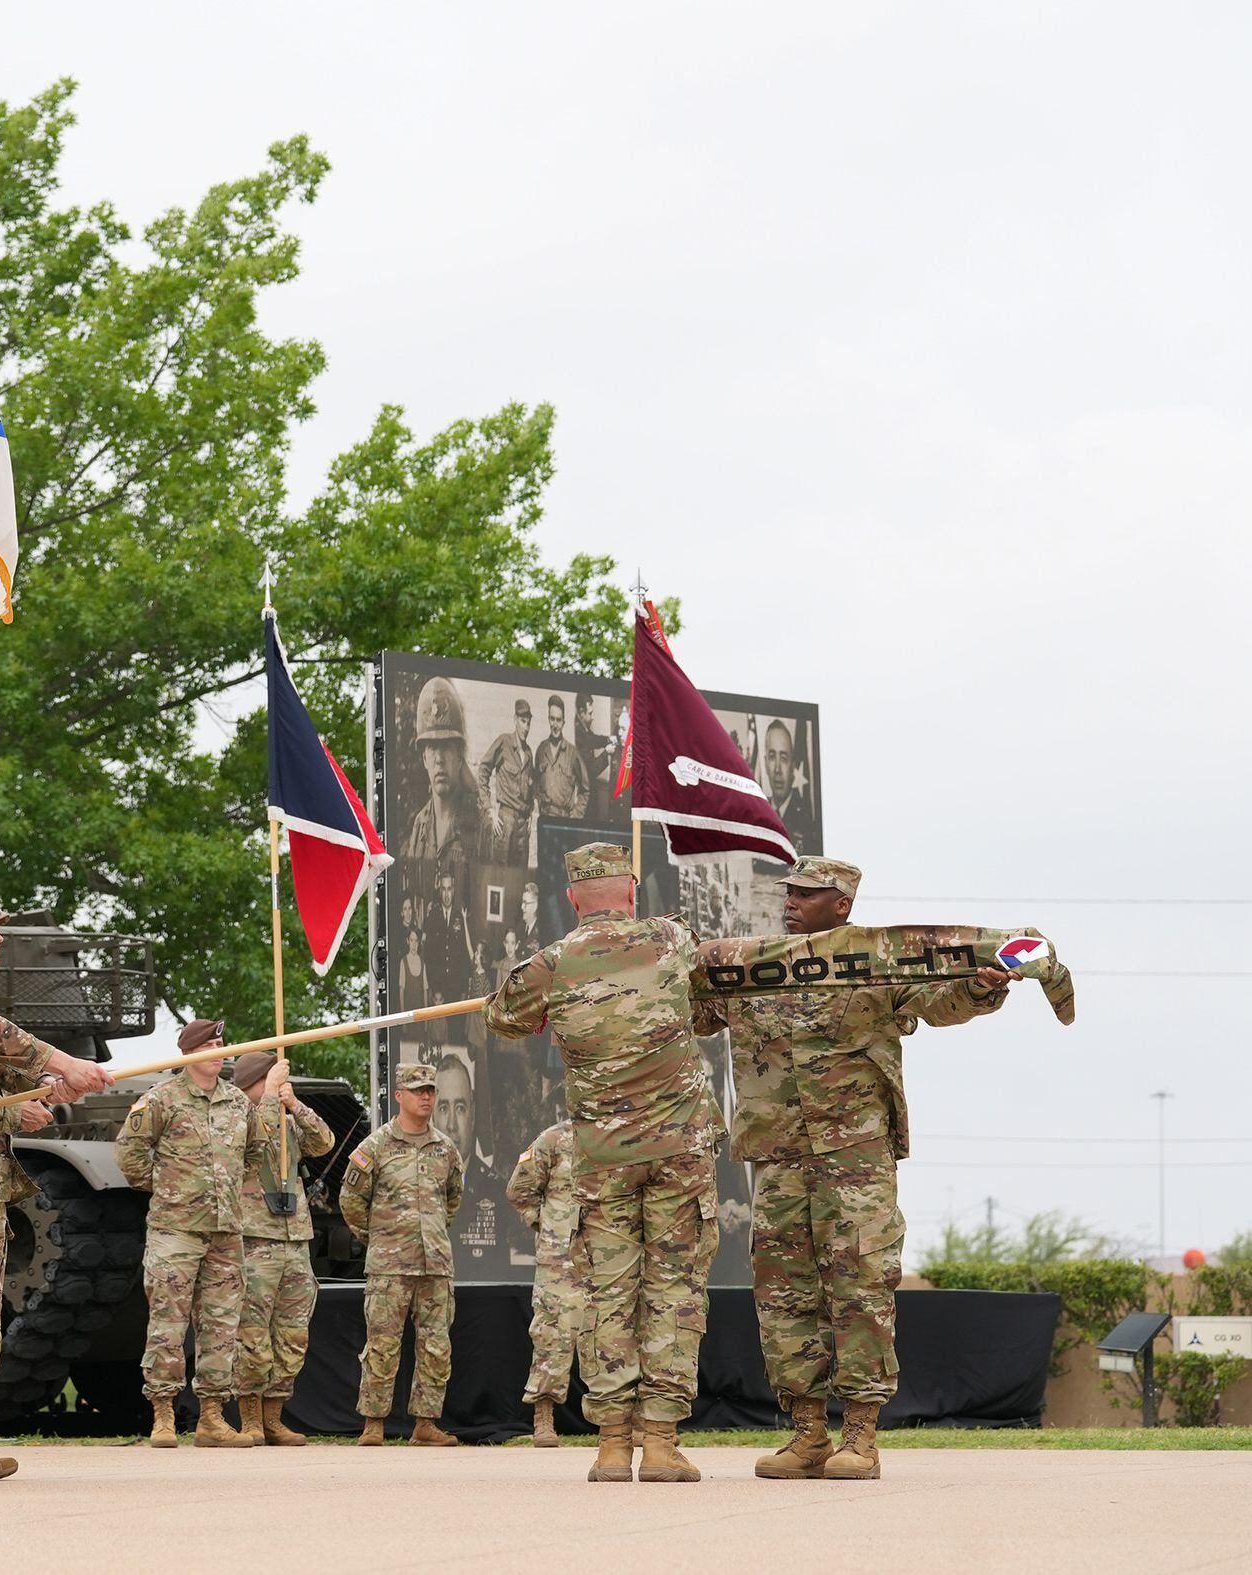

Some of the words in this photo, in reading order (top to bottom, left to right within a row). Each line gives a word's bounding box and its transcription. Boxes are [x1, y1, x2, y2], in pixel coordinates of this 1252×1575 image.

[686, 762, 704, 777] CARL
[577, 868, 605, 878] FOSTER
[896, 945, 977, 972] FT
[708, 951, 872, 988] HOOD
